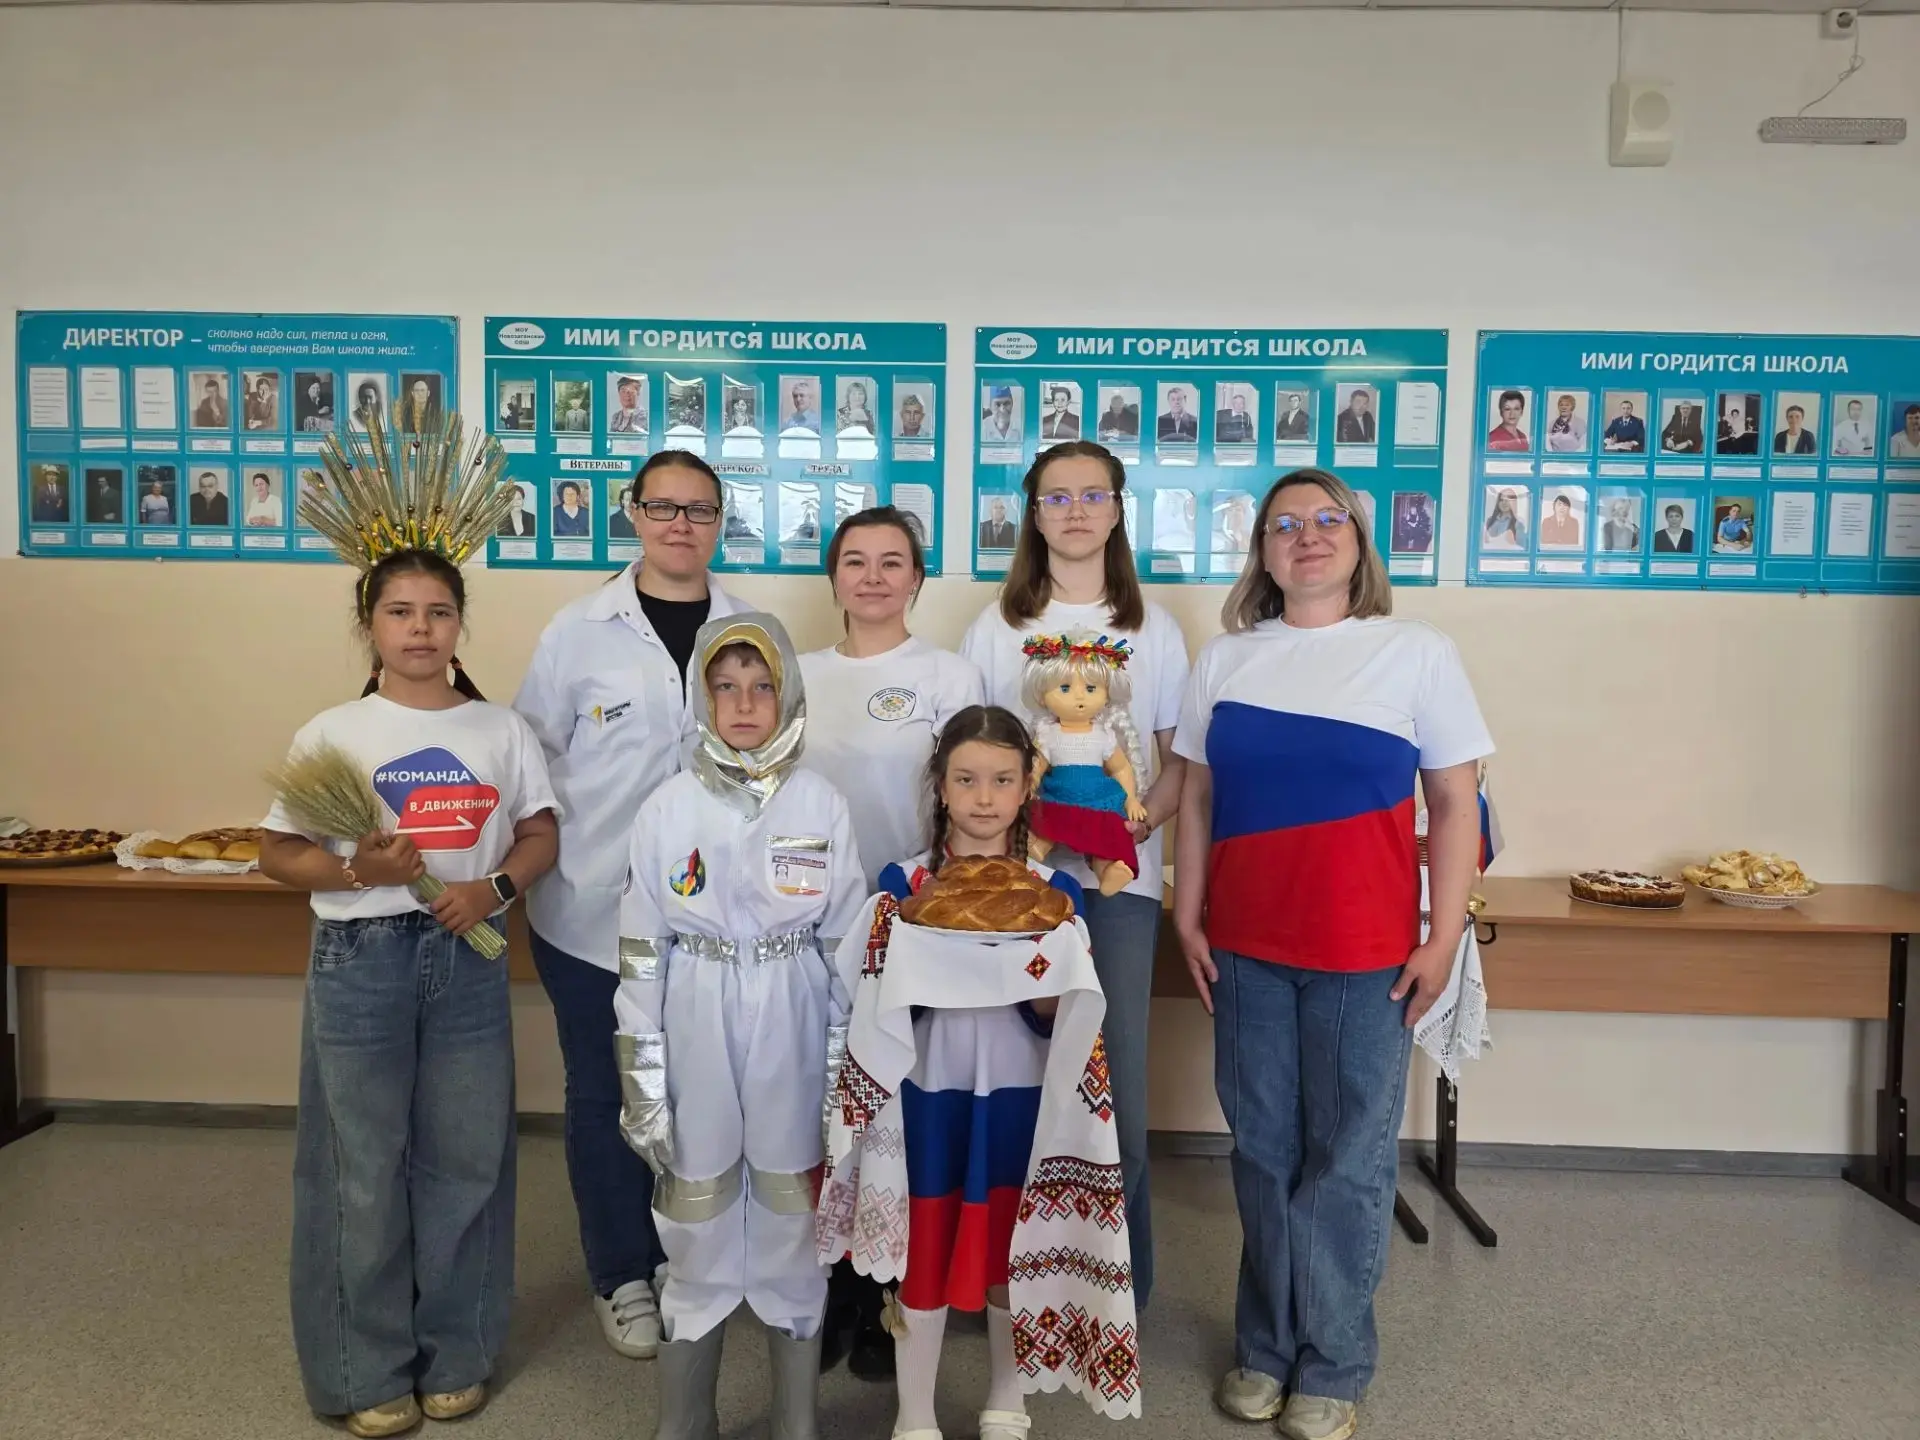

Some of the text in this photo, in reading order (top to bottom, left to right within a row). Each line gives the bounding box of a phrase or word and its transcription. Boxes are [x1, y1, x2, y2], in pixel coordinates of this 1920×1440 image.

[63, 327, 184, 350] ДИРЕКТОР
[207, 327, 389, 342] сколько надо сил, тепла и огня,
[564, 328, 867, 350] ИМИ ГОРДИТСЯ ШКОЛА
[207, 341, 247, 354] чтобы
[250, 344, 308, 356] вверенная
[312, 344, 335, 355] Вам
[338, 345, 375, 356] школа
[1057, 337, 1368, 358] ИМИ ГОРДИТСЯ ШКОЛА
[1581, 352, 1849, 374] ИМИ ГОРДИТСЯ ШКОЛА
[375, 770, 471, 784] #КОМАНДА
